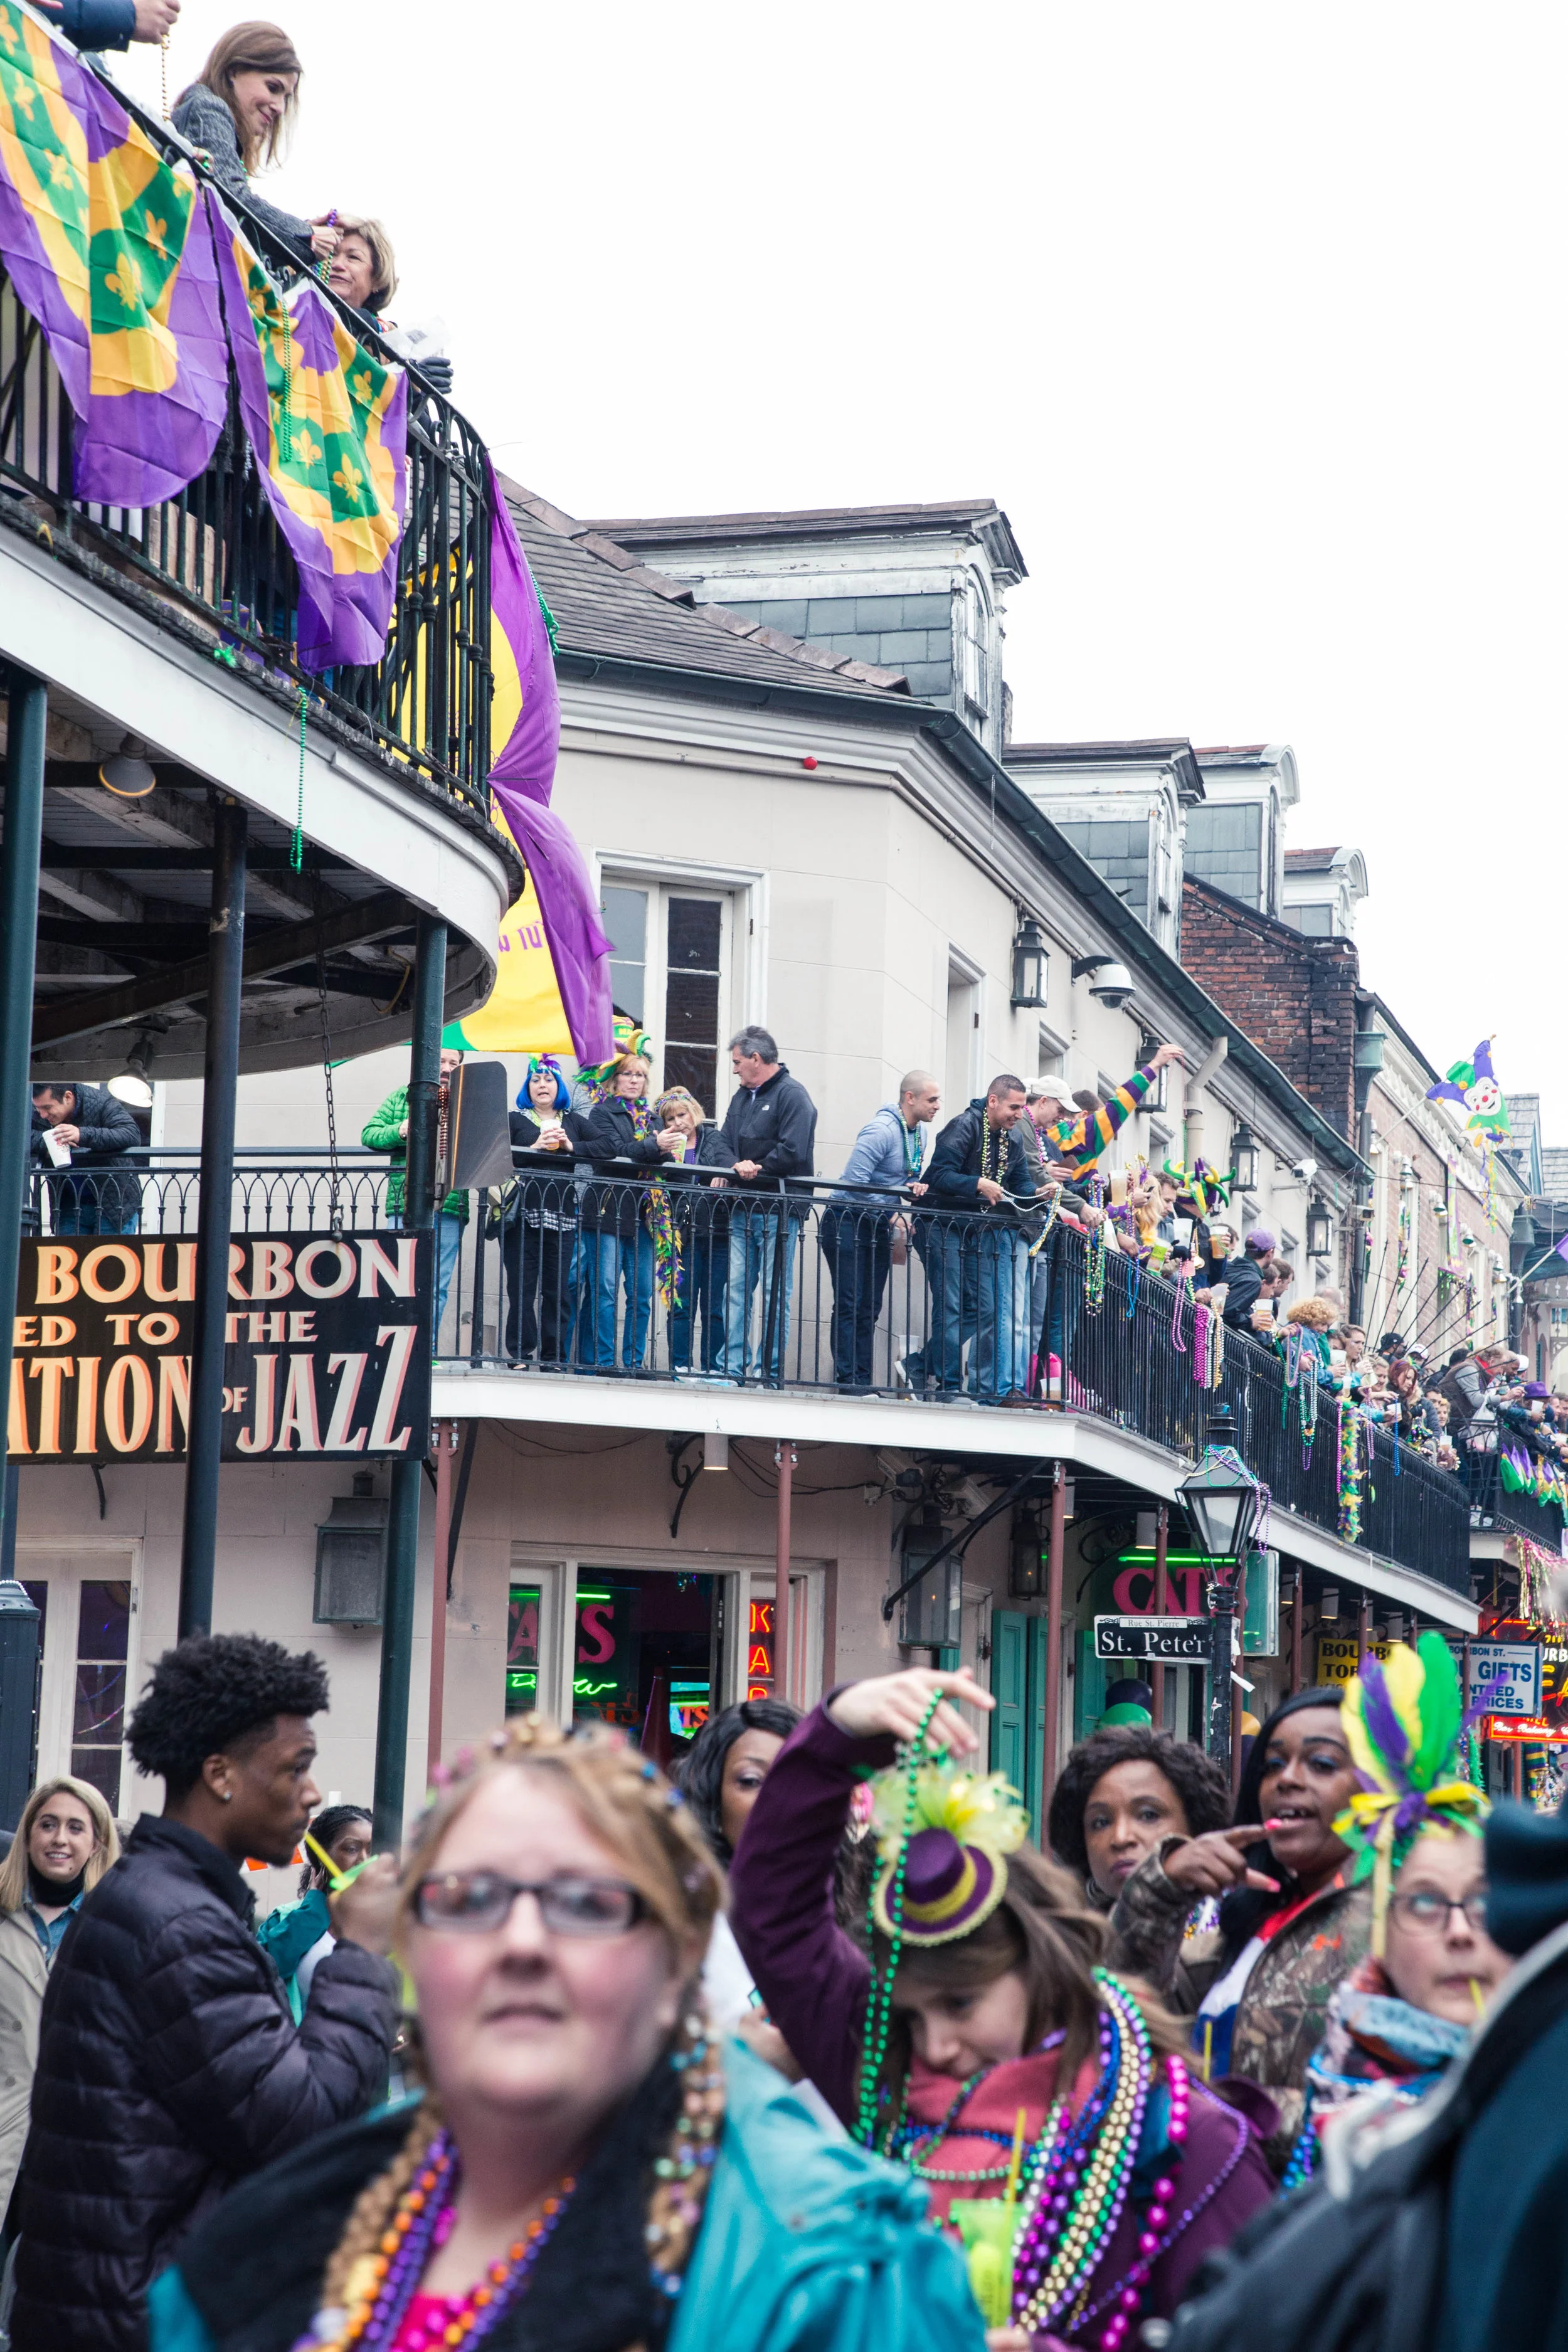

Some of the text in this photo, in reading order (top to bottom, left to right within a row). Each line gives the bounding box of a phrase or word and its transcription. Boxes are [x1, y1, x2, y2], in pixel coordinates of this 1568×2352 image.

[104, 1312, 180, 1345] TO
[225, 1311, 319, 1343] THE
[236, 1325, 418, 1453] JAZZ
[1101, 1631, 1205, 1653] St. Peter
[1493, 1648, 1505, 1656] ST.
[1478, 1661, 1532, 1682] GIFTS
